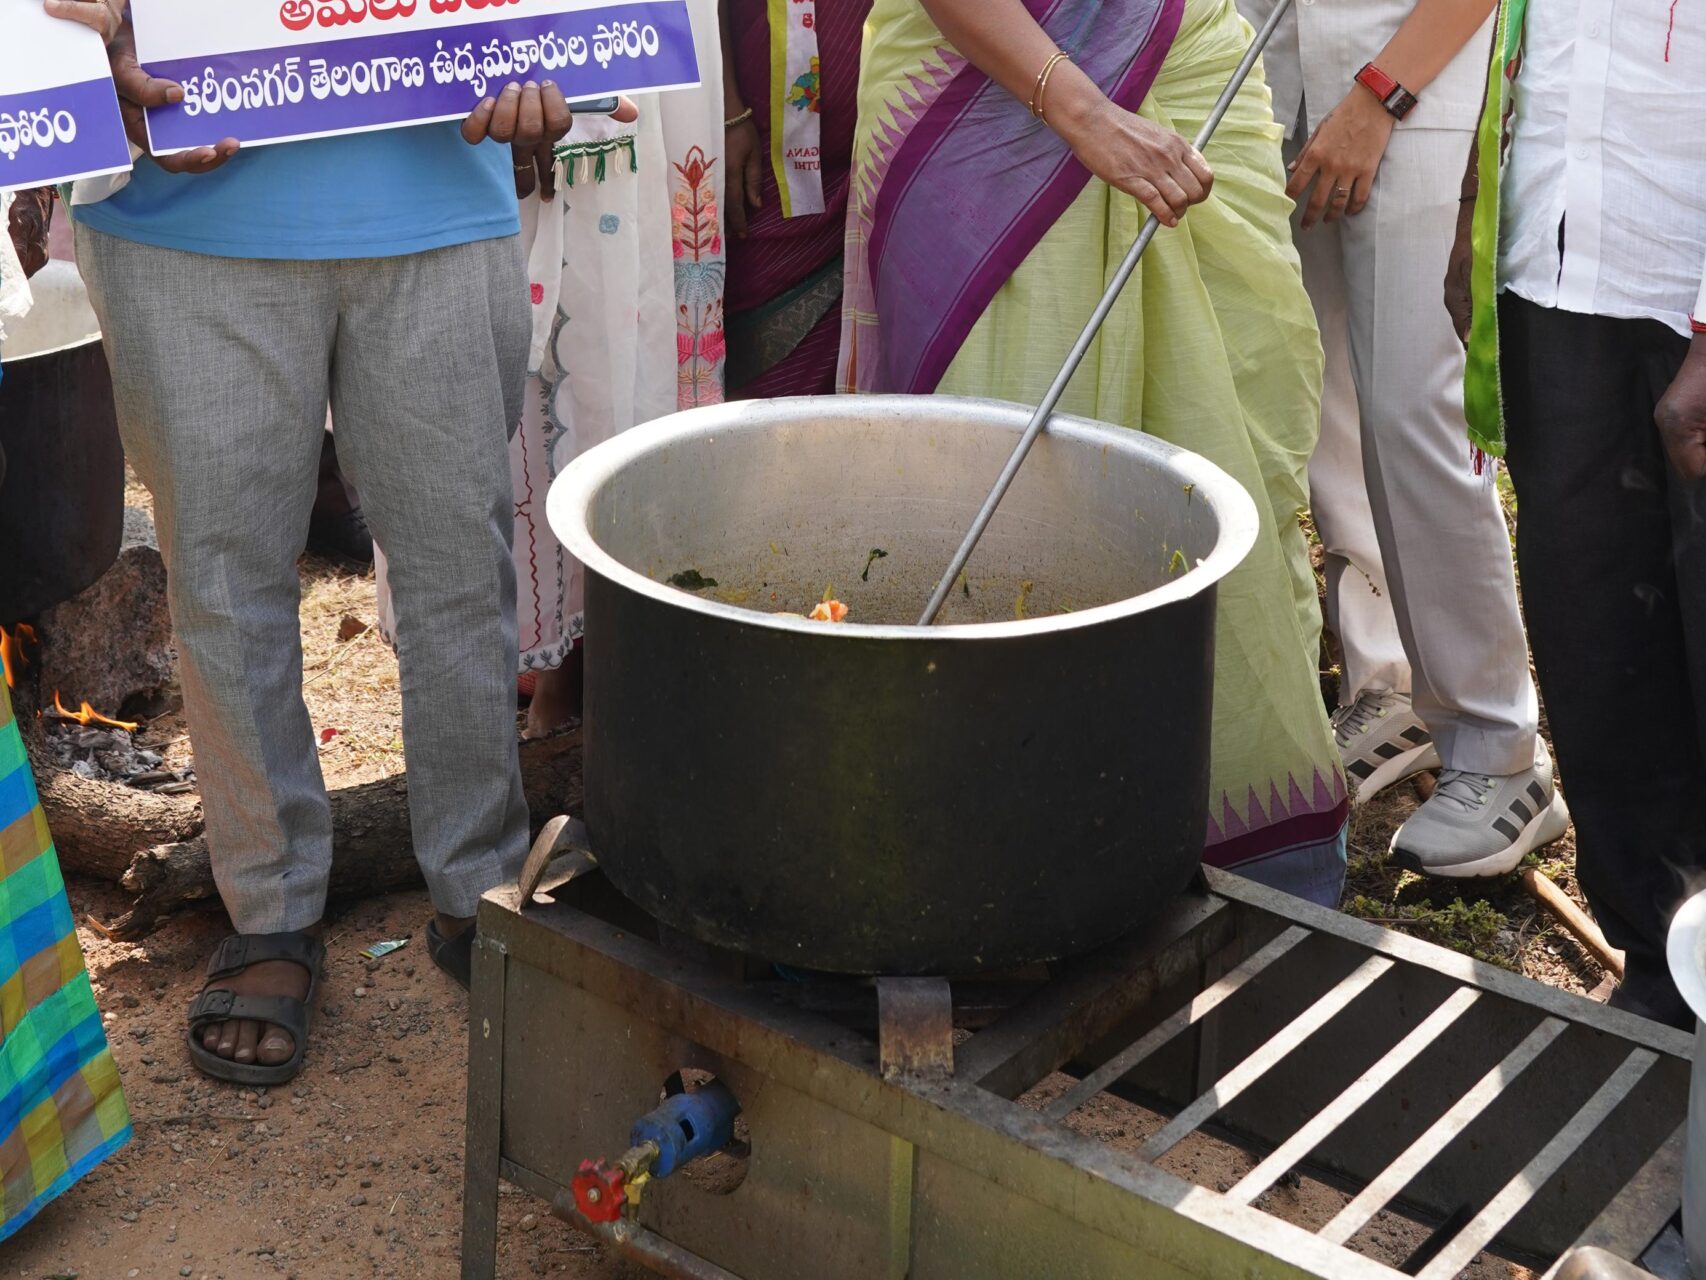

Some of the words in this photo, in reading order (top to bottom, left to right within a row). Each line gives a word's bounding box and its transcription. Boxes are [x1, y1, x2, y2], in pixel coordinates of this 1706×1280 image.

[182, 56, 305, 116] కరీంనగర్
[309, 56, 425, 100] తెలంగాణ
[430, 31, 588, 98] ఉద్యమకారుల
[592, 20, 660, 70] ఫోరం
